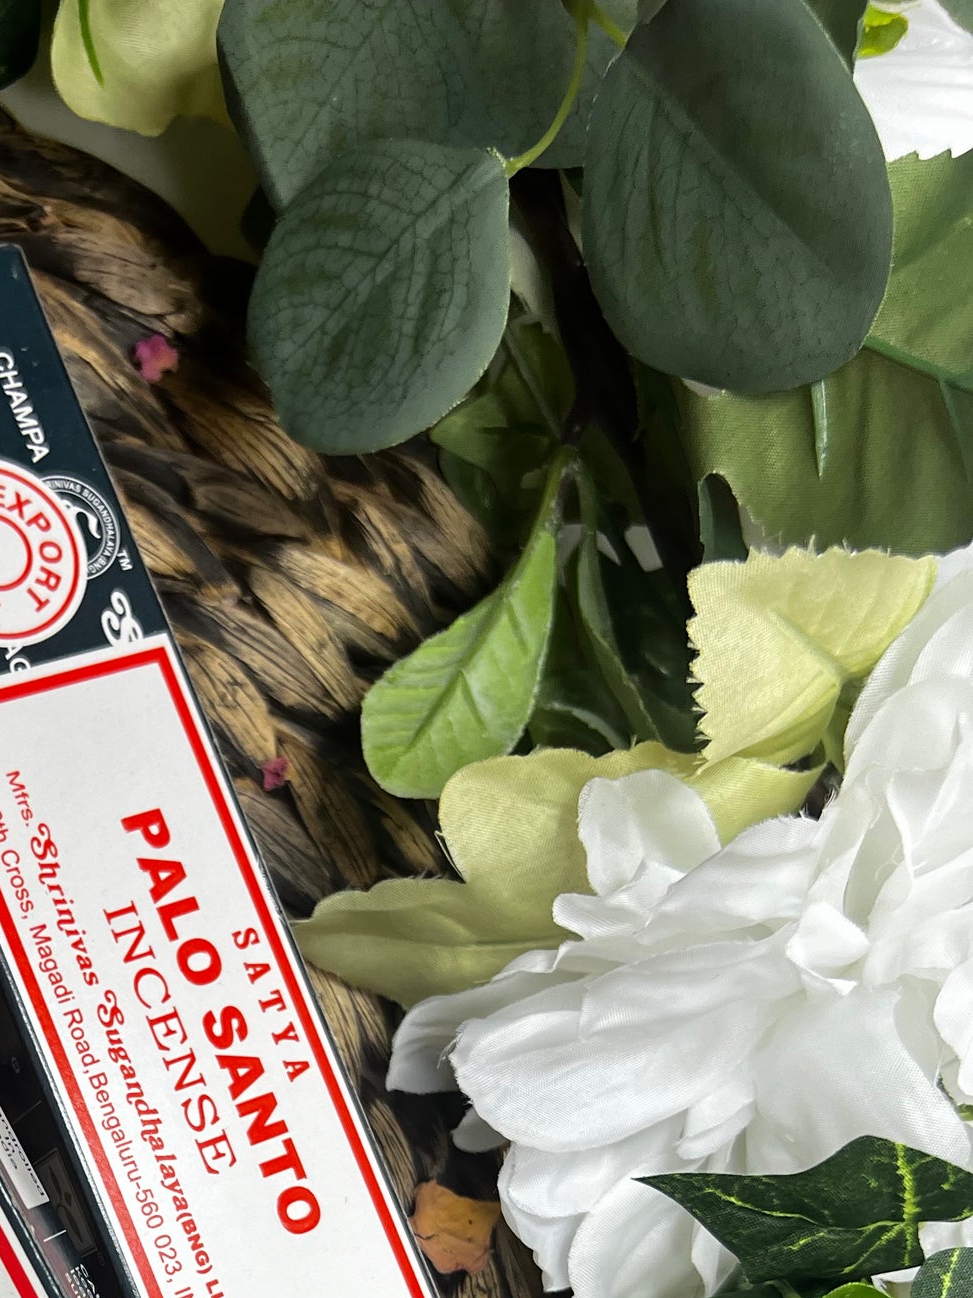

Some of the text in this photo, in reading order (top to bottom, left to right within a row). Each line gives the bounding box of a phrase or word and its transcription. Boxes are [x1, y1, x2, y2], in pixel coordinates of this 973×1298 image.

[6, 770, 43, 826] Mfrs.
[30, 823, 99, 986] Shrinivas
[231, 927, 310, 1082] SATYA
[0, 849, 34, 919] Cross,
[30, 923, 82, 1017] Magadi
[154, 1234, 182, 1282] 023,
[103, 901, 237, 1174] INCENSE
[120, 807, 321, 1235] PALO SANTO
